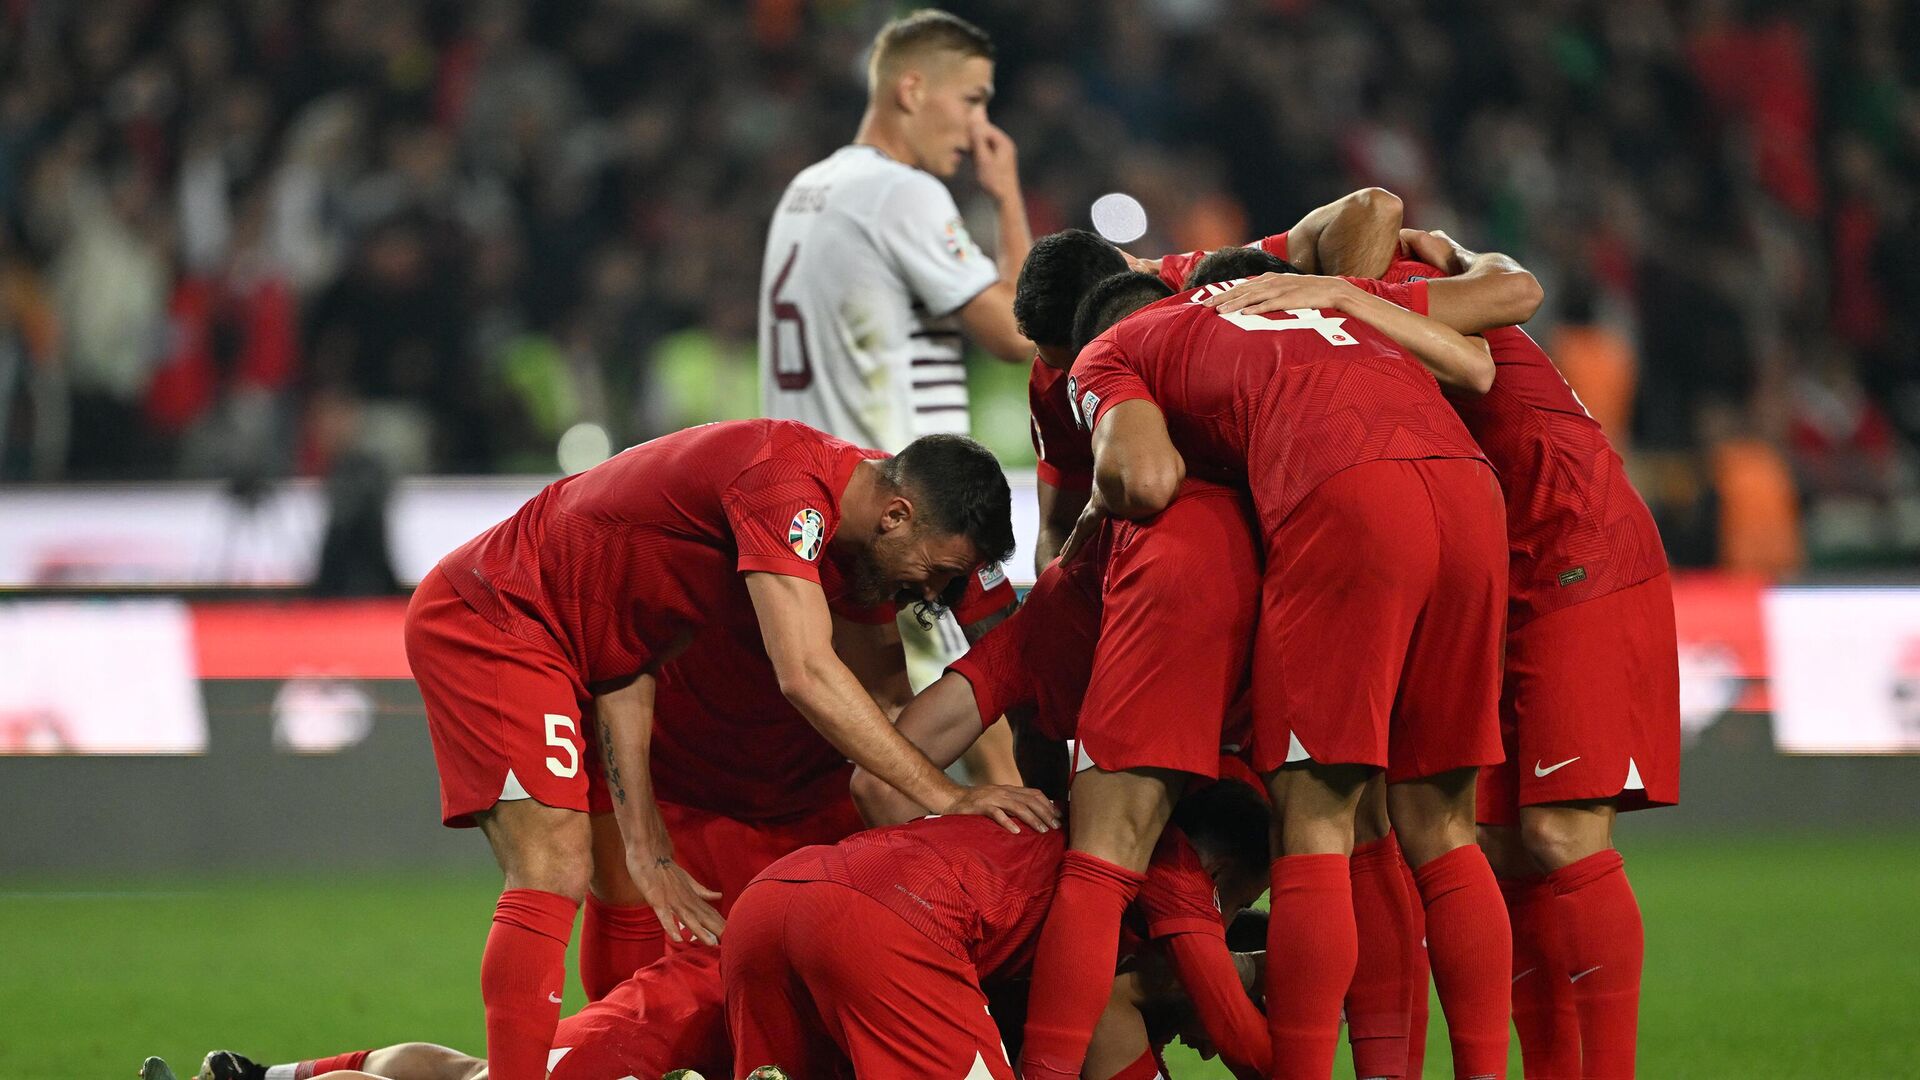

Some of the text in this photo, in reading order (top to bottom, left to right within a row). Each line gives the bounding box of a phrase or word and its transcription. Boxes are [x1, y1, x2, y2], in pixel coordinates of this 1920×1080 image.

[770, 242, 813, 391] 6
[1217, 307, 1361, 347] 4
[543, 713, 579, 778] 5
